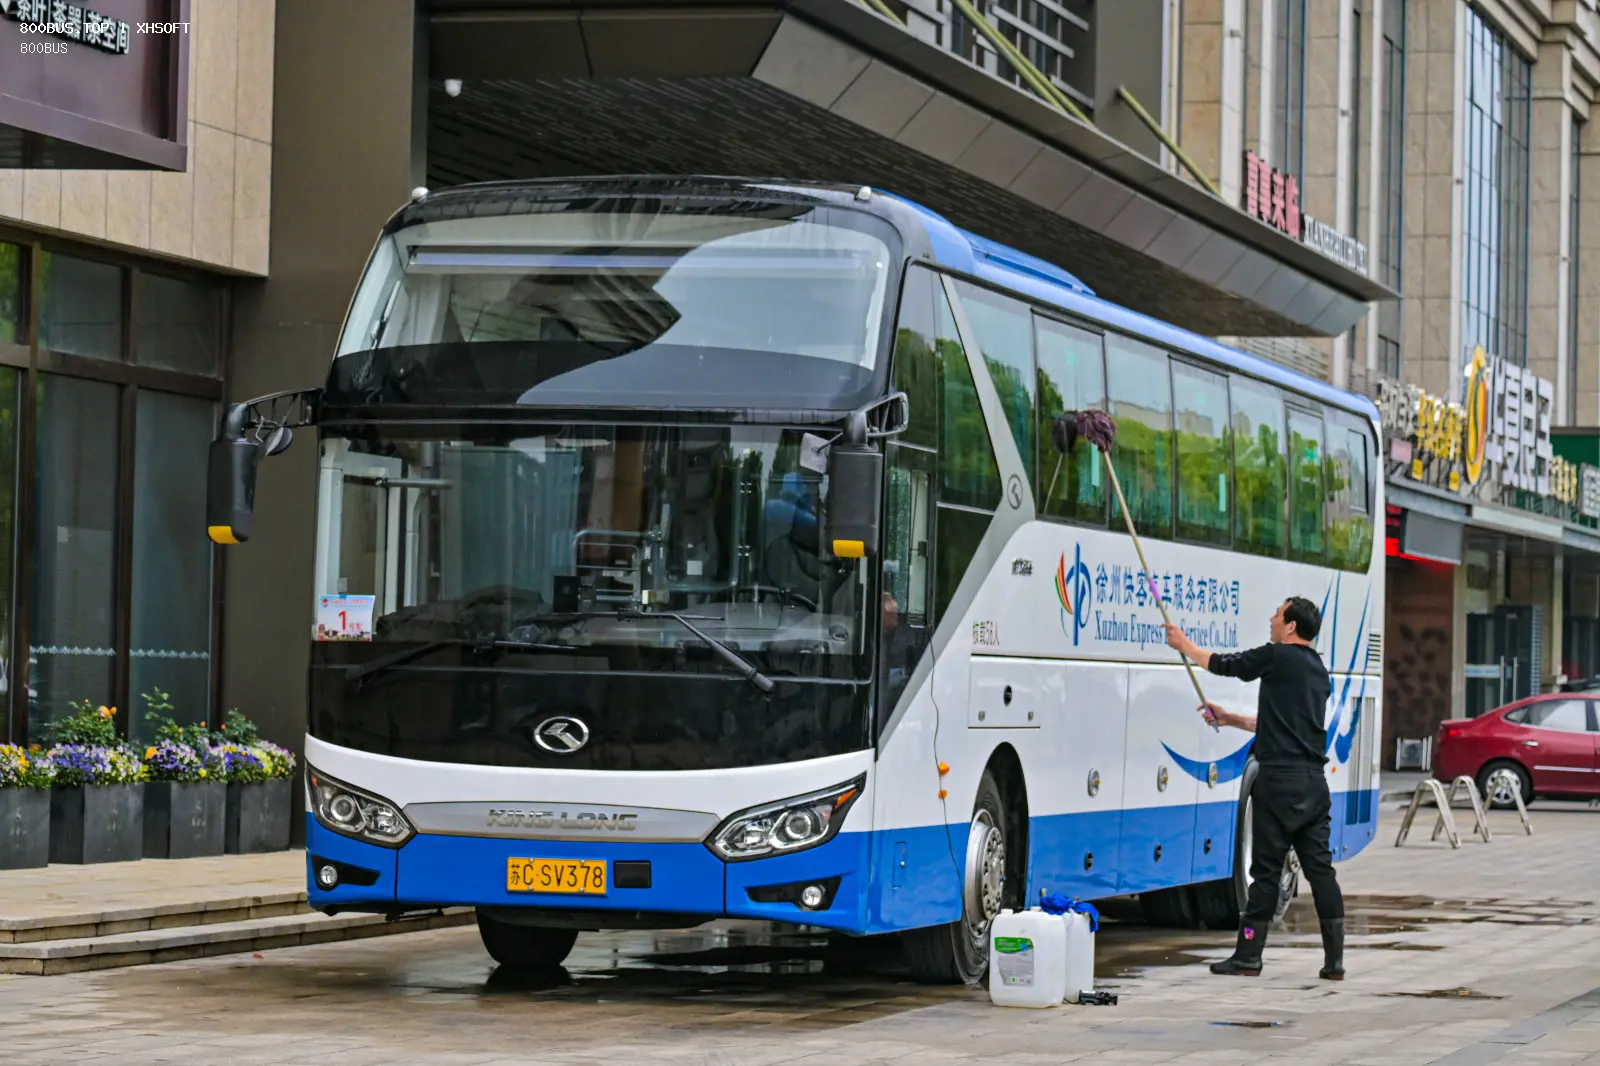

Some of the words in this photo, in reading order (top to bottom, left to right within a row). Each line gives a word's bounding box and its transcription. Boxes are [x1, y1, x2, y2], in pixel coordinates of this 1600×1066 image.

[338, 610, 347, 630] 1
[1095, 610, 1128, 641] Xuzhou
[1130, 614, 1163, 651] Express
[487, 809, 554, 828] KING
[560, 812, 638, 831] LONG
